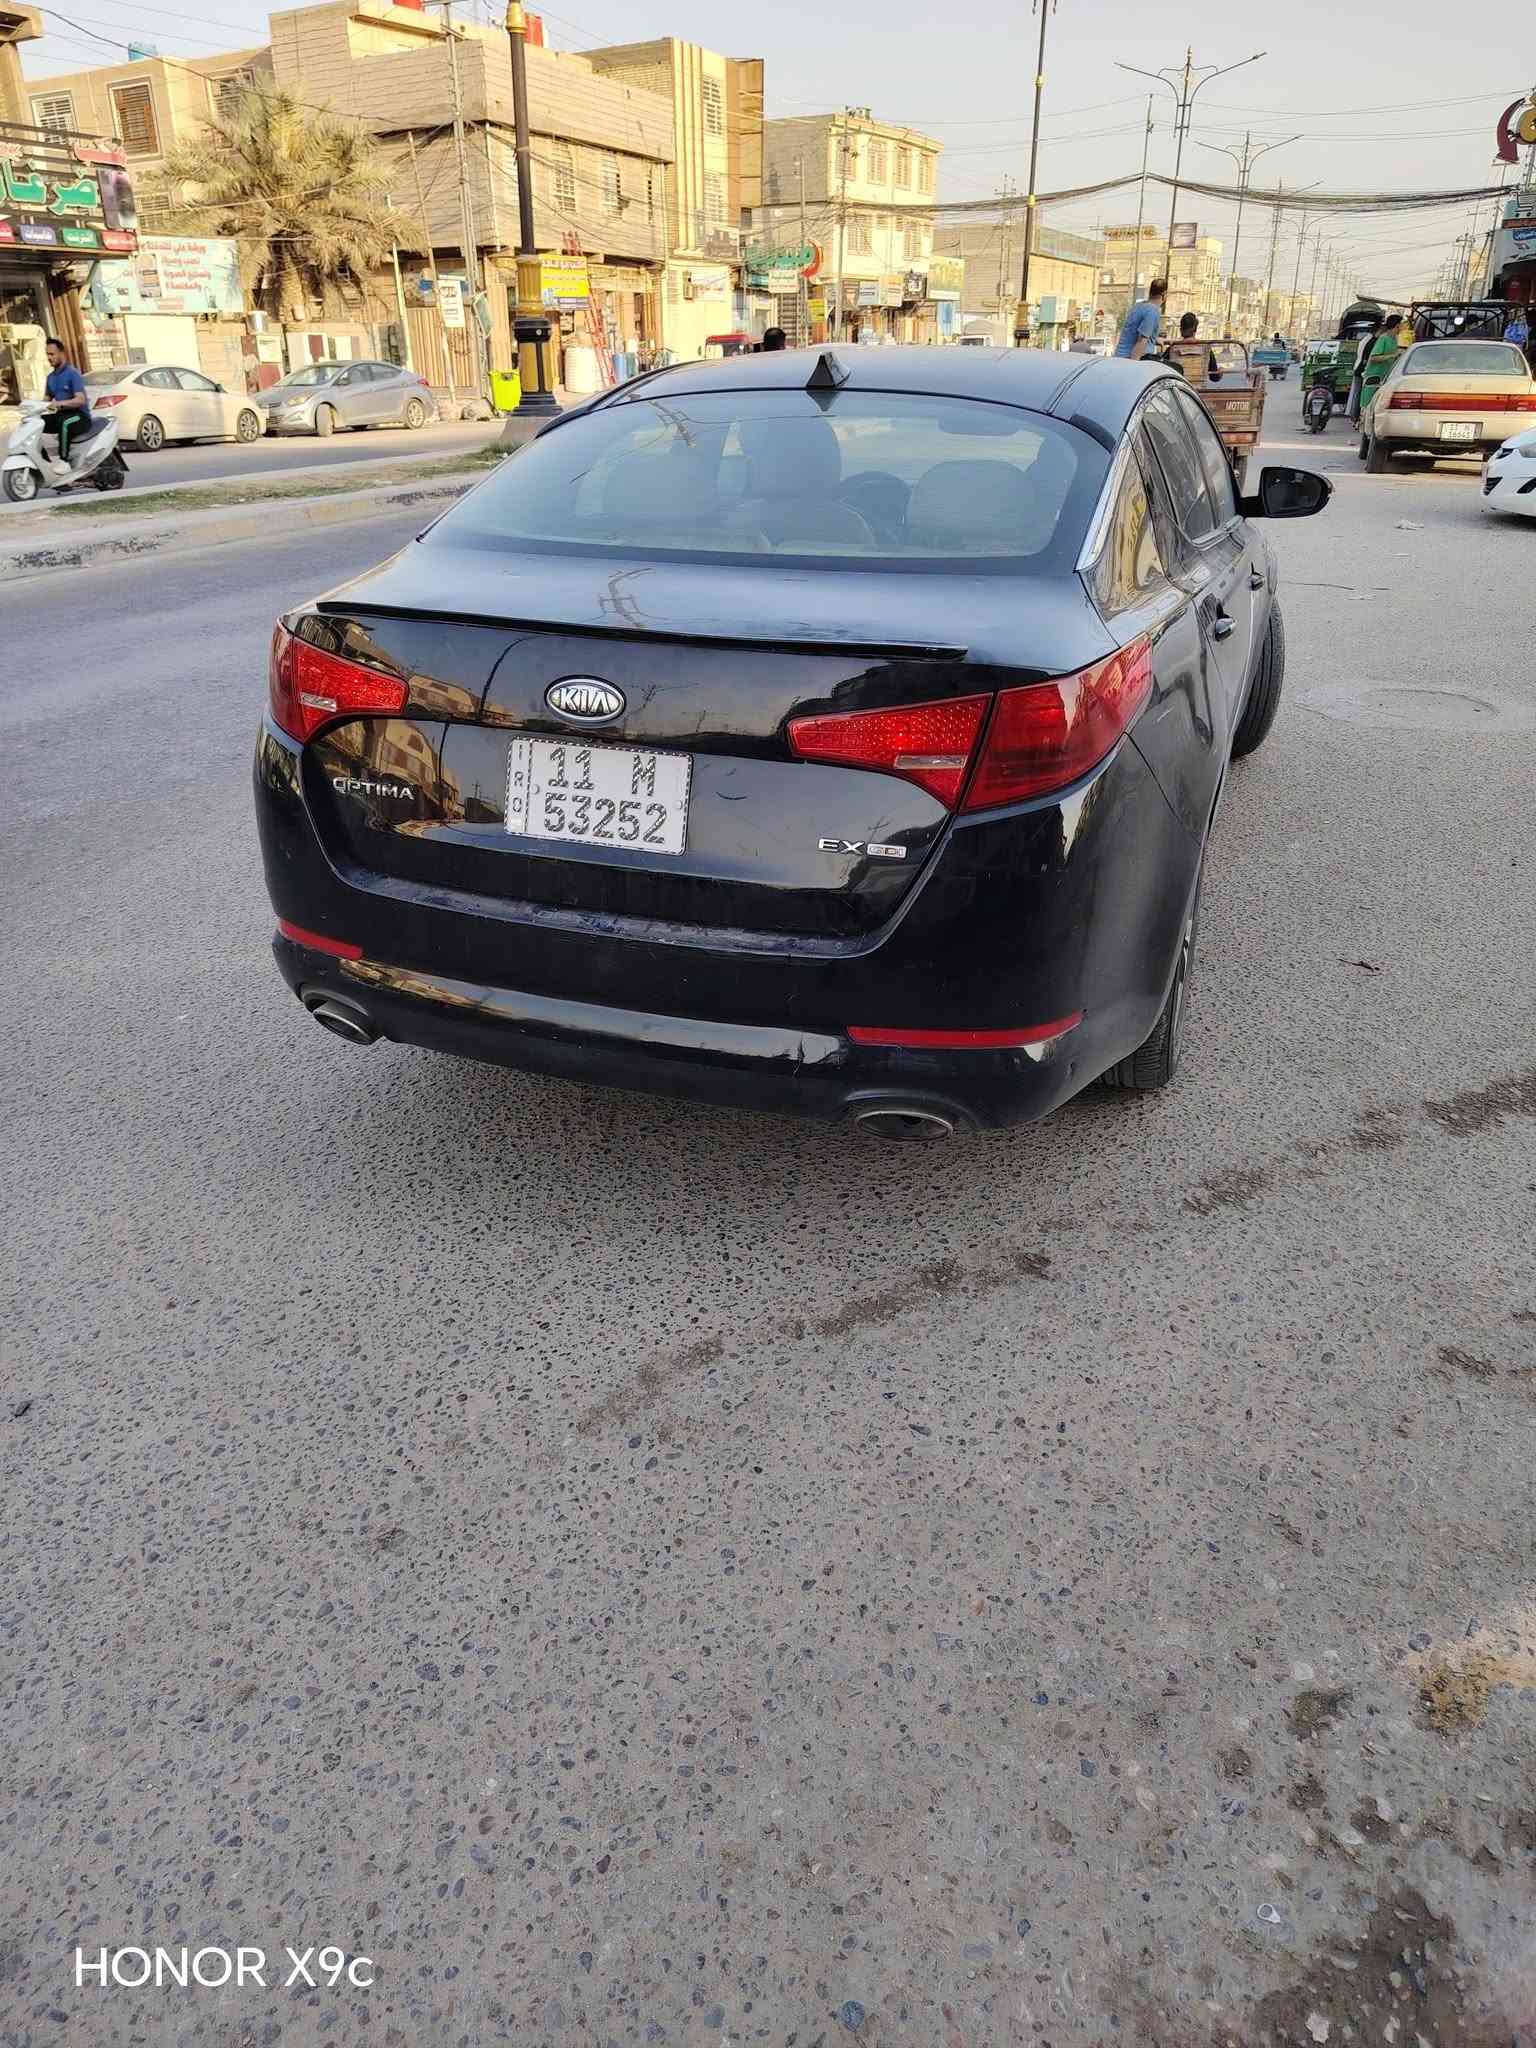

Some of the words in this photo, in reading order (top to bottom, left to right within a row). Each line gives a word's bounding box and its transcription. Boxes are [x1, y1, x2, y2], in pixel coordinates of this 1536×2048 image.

[558, 686, 613, 713] KIA
[548, 747, 594, 790] 11
[332, 776, 416, 801] OPTIMA
[544, 792, 668, 844] 53252
[818, 838, 865, 854] EX
